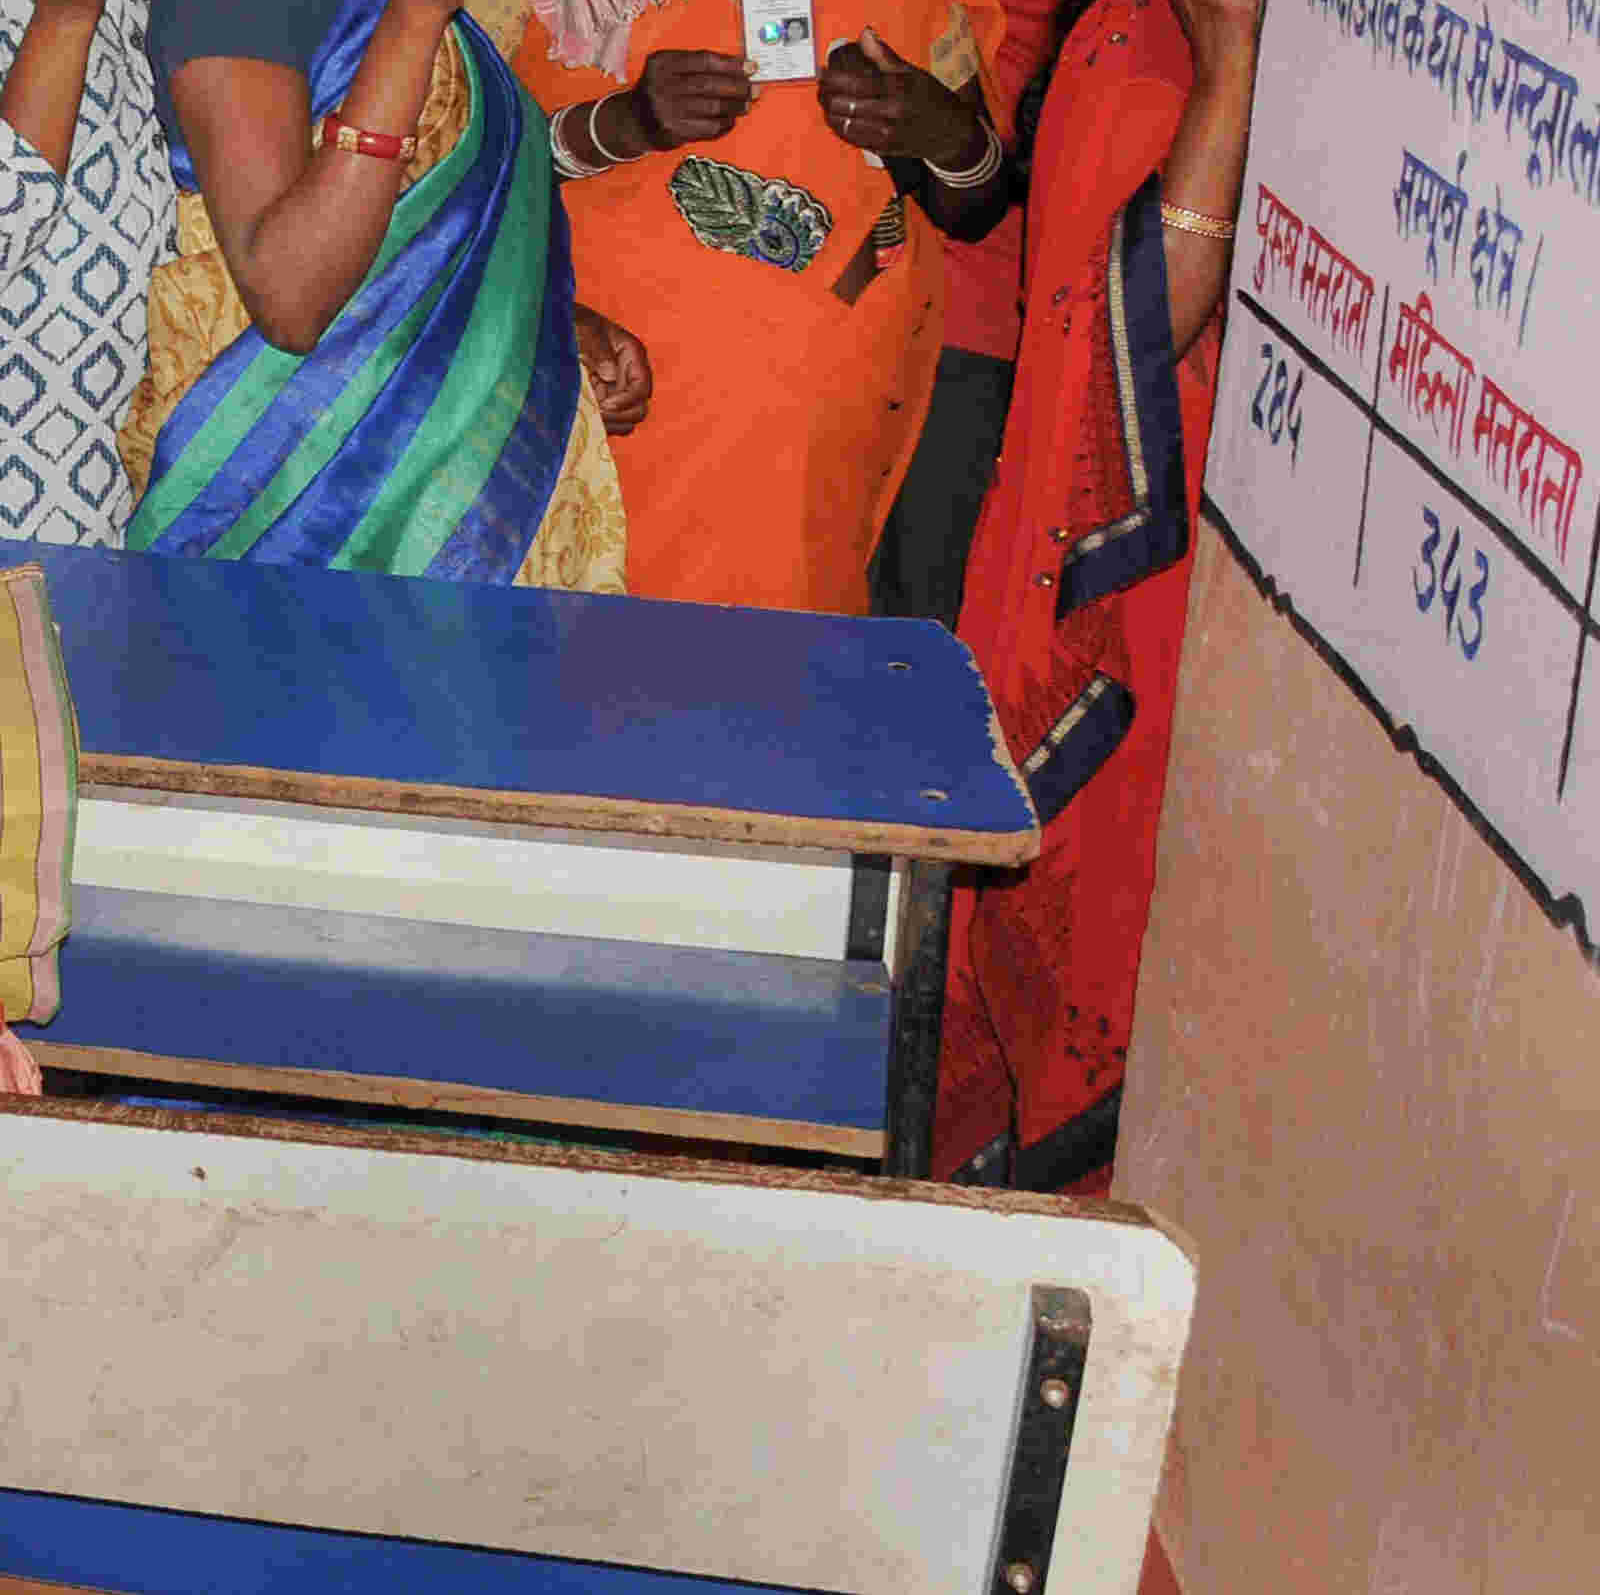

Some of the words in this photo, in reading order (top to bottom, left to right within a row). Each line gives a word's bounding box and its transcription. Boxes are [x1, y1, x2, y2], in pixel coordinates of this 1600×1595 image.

[1250, 341, 1304, 474] 284
[1473, 373, 1583, 566] मतदाता
[1412, 505, 1490, 661] 343
